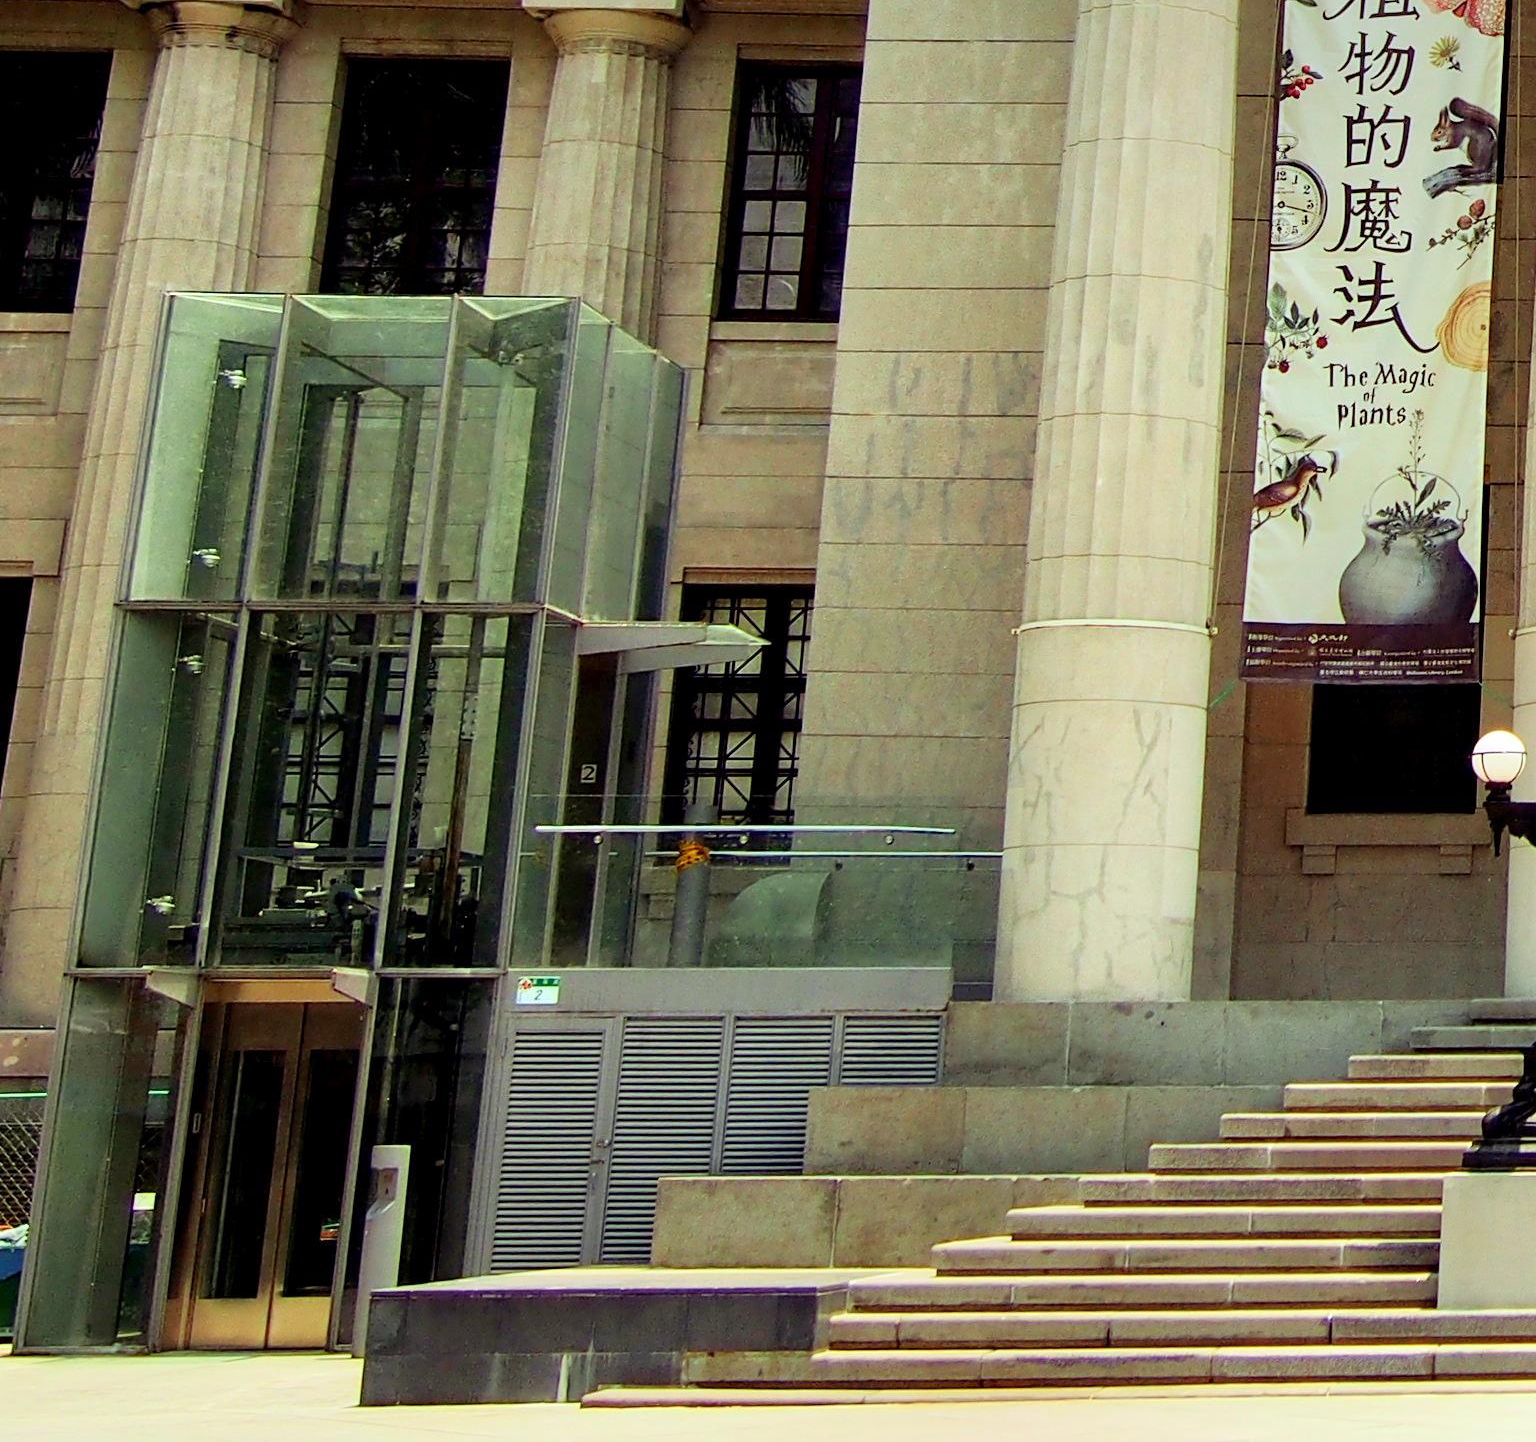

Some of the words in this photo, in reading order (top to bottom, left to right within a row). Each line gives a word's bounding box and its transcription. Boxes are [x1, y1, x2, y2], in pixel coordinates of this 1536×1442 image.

[1322, 362, 1369, 388] The
[1374, 361, 1437, 394] Magic
[1363, 386, 1378, 405] of
[1337, 401, 1407, 431] Plants
[583, 765, 595, 780] 2
[534, 989, 543, 1000] 2
